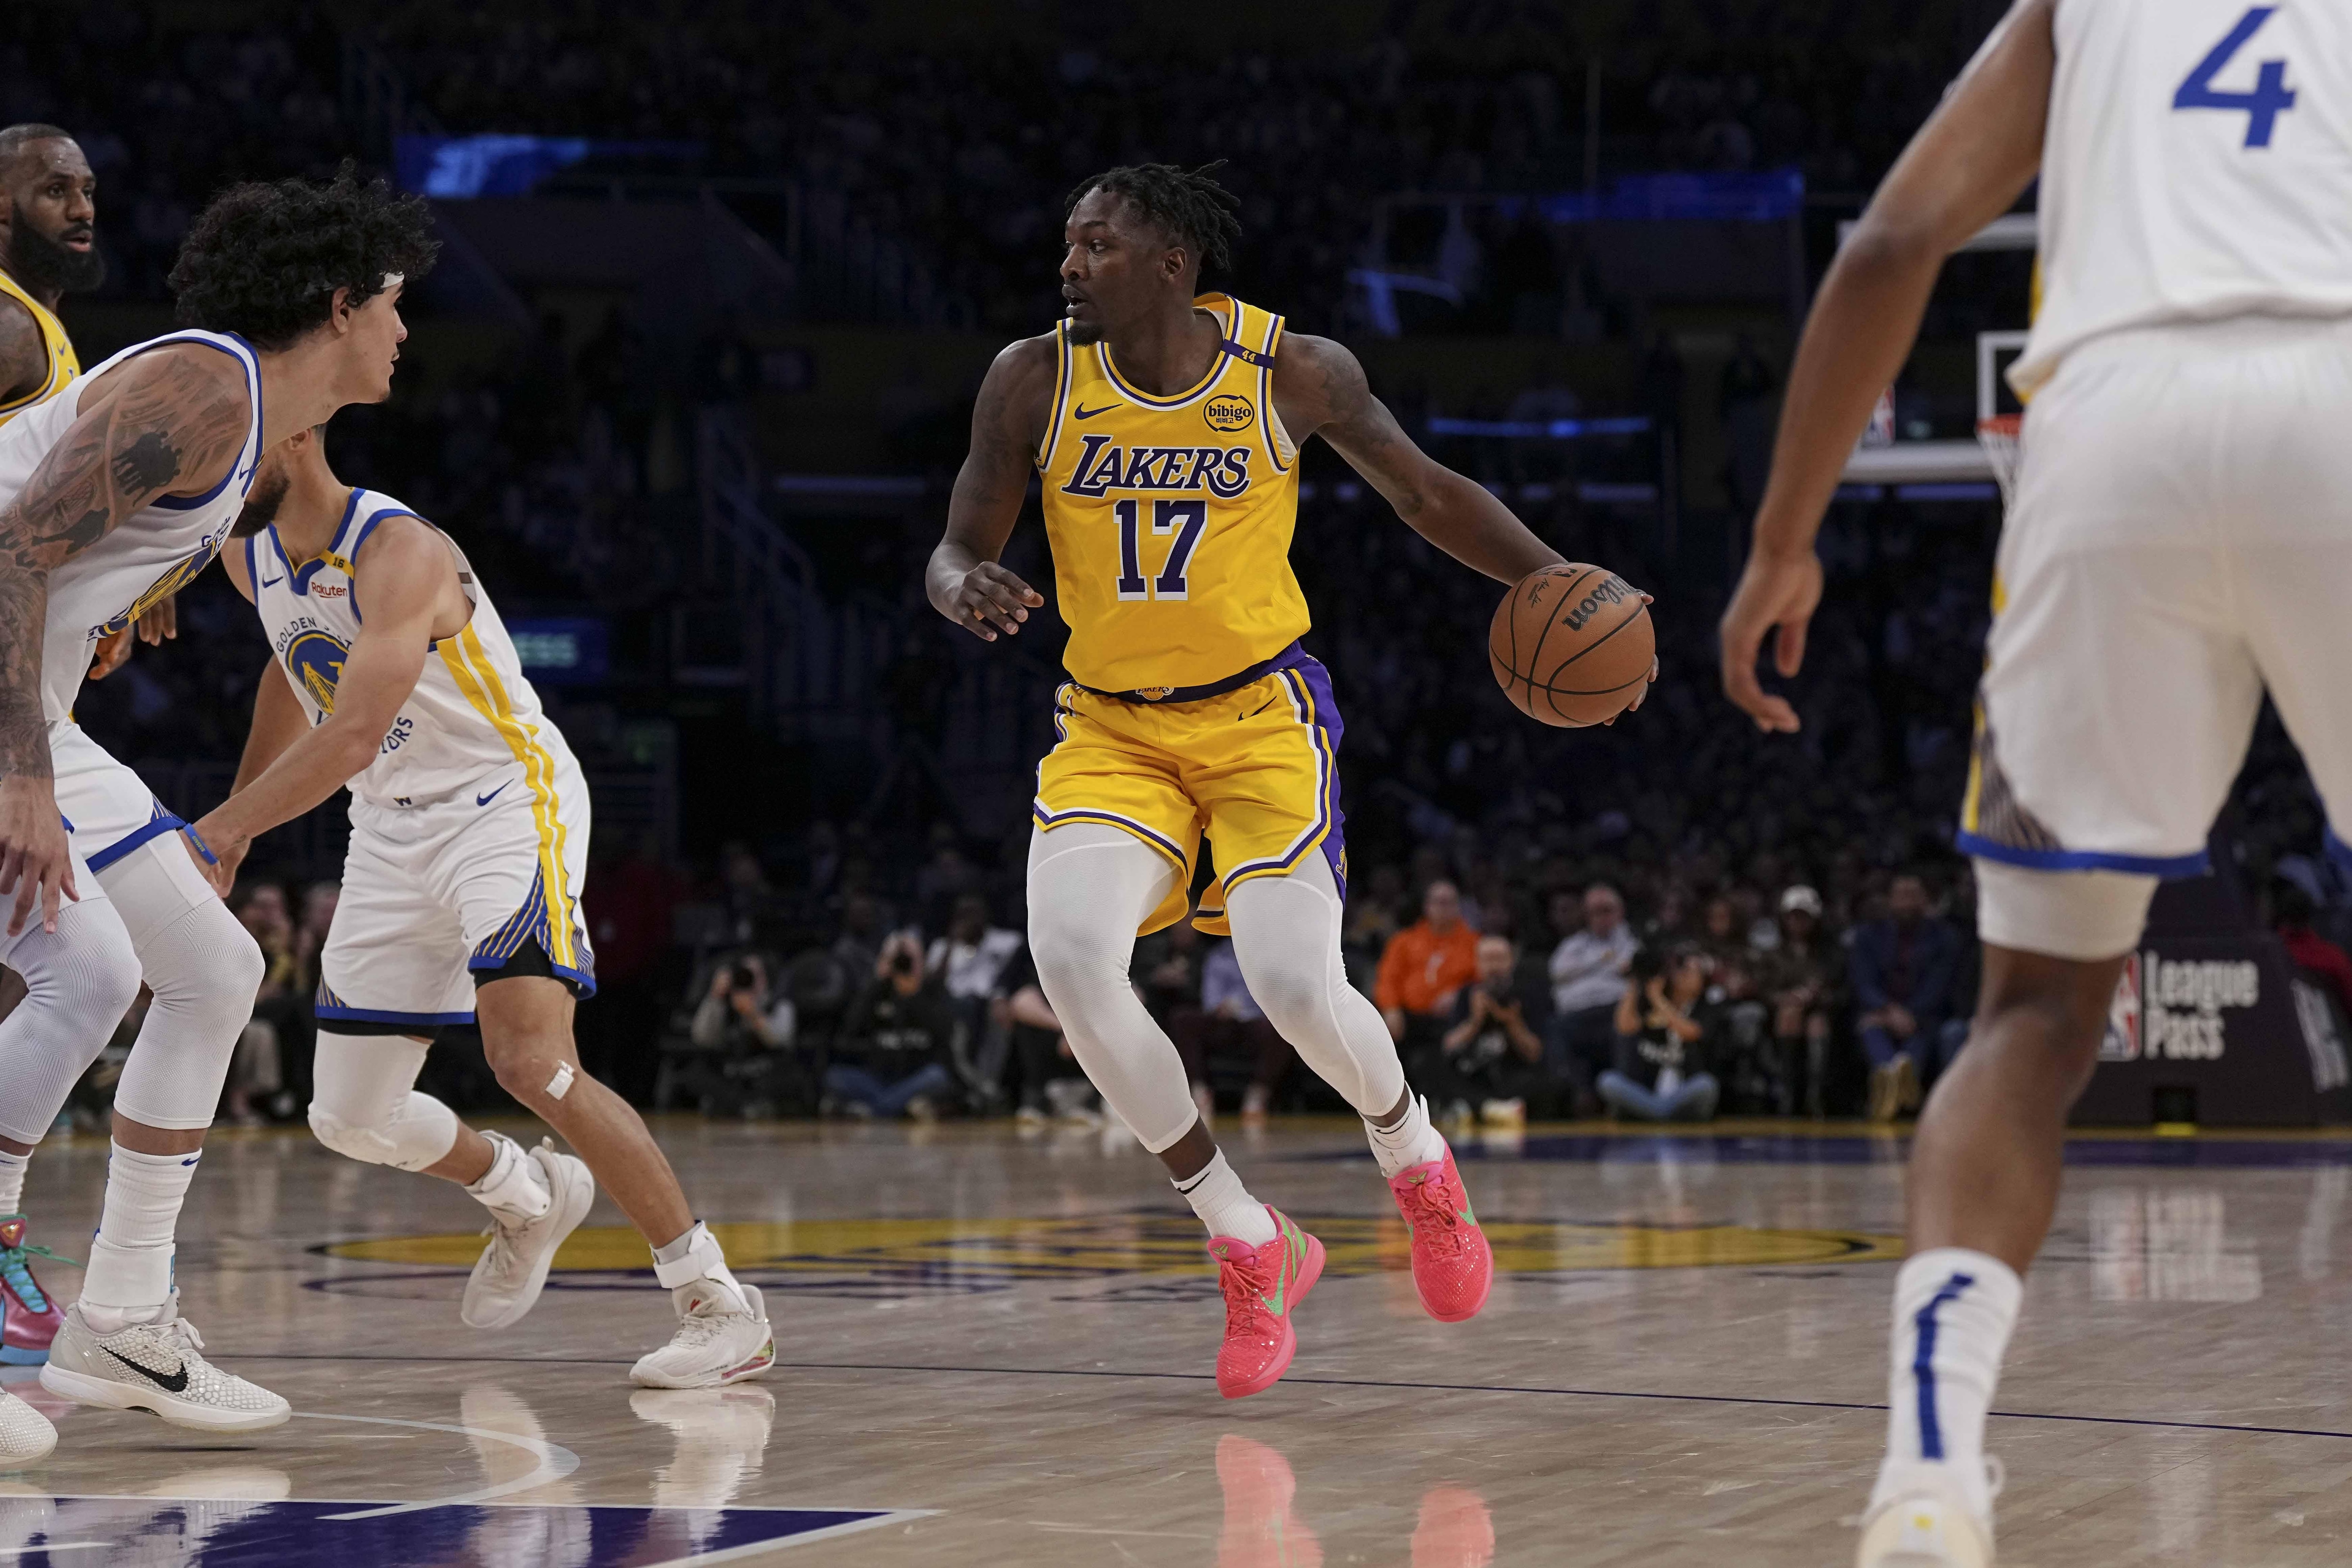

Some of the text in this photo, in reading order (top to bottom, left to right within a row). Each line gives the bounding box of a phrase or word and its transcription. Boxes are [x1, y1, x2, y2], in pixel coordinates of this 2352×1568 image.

[2171, 5, 2296, 149] 4
[1242, 350, 1256, 362] 44
[1208, 404, 1251, 421] bibigo
[1059, 434, 1252, 500] LAKERS
[333, 557, 345, 568] 16
[1113, 498, 1208, 601] 17
[311, 582, 348, 597] Rakuten
[276, 617, 318, 653] GOLDEN
[2145, 950, 2258, 1011] League
[2145, 1007, 2225, 1060] Pass
